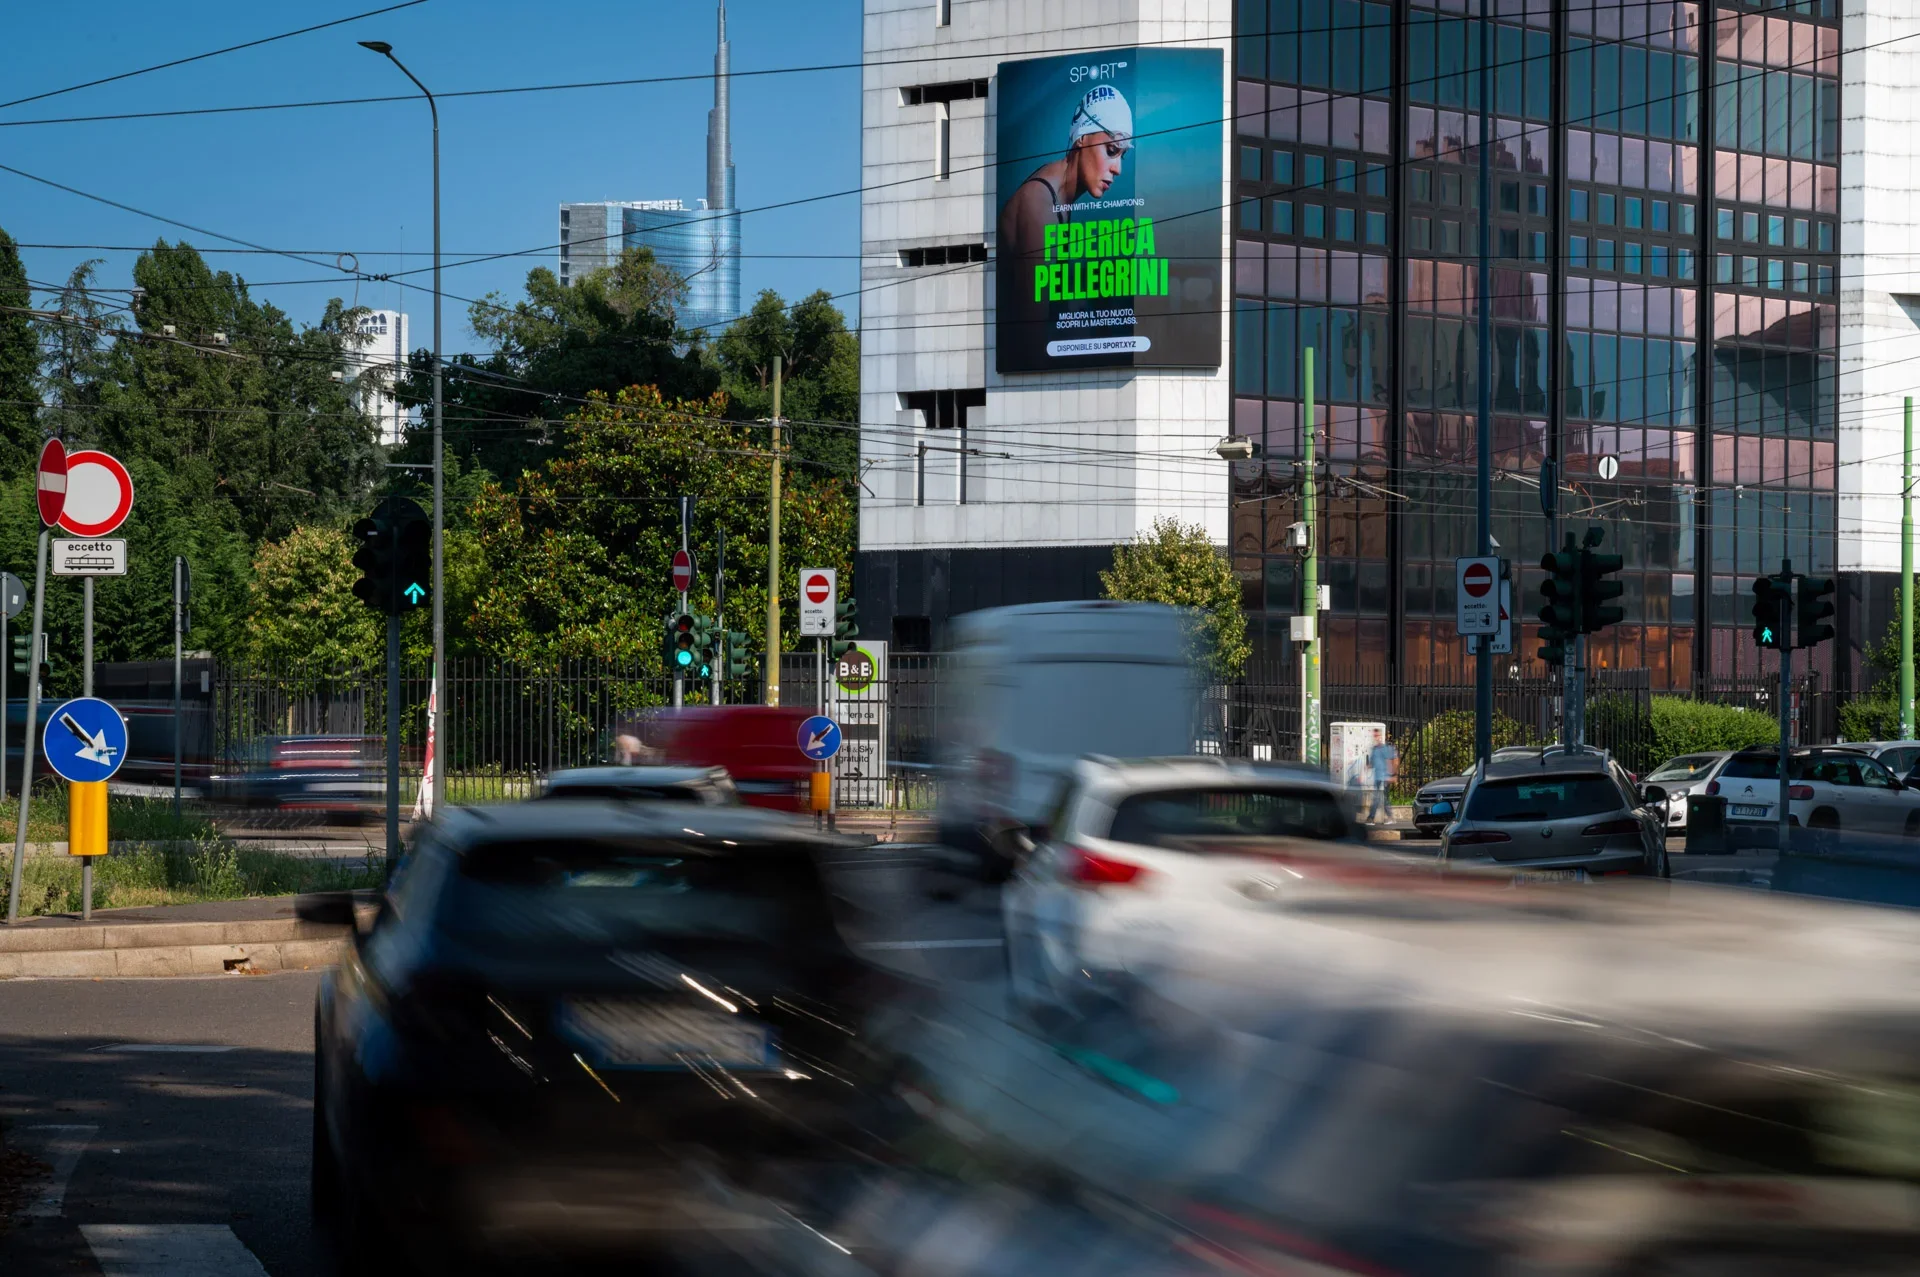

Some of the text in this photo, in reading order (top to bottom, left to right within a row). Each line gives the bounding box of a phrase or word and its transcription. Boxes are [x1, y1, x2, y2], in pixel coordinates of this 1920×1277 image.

[1086, 88, 1115, 105] FEDE
[1052, 198, 1145, 212] LEARN WITH THE CHAMPIONS
[1044, 217, 1155, 261] FEDERICA
[1035, 258, 1168, 302] PELLEGRINI
[1059, 308, 1134, 320] MIGLIORA IL TUO NUOTO.
[1056, 320, 1080, 329] SCOPRI
[1090, 317, 1138, 327] MASTERCLASS.
[1057, 344, 1092, 352] DISPONIBILE
[1102, 341, 1136, 349] SPORT.XYZ
[68, 542, 112, 551] eccetto
